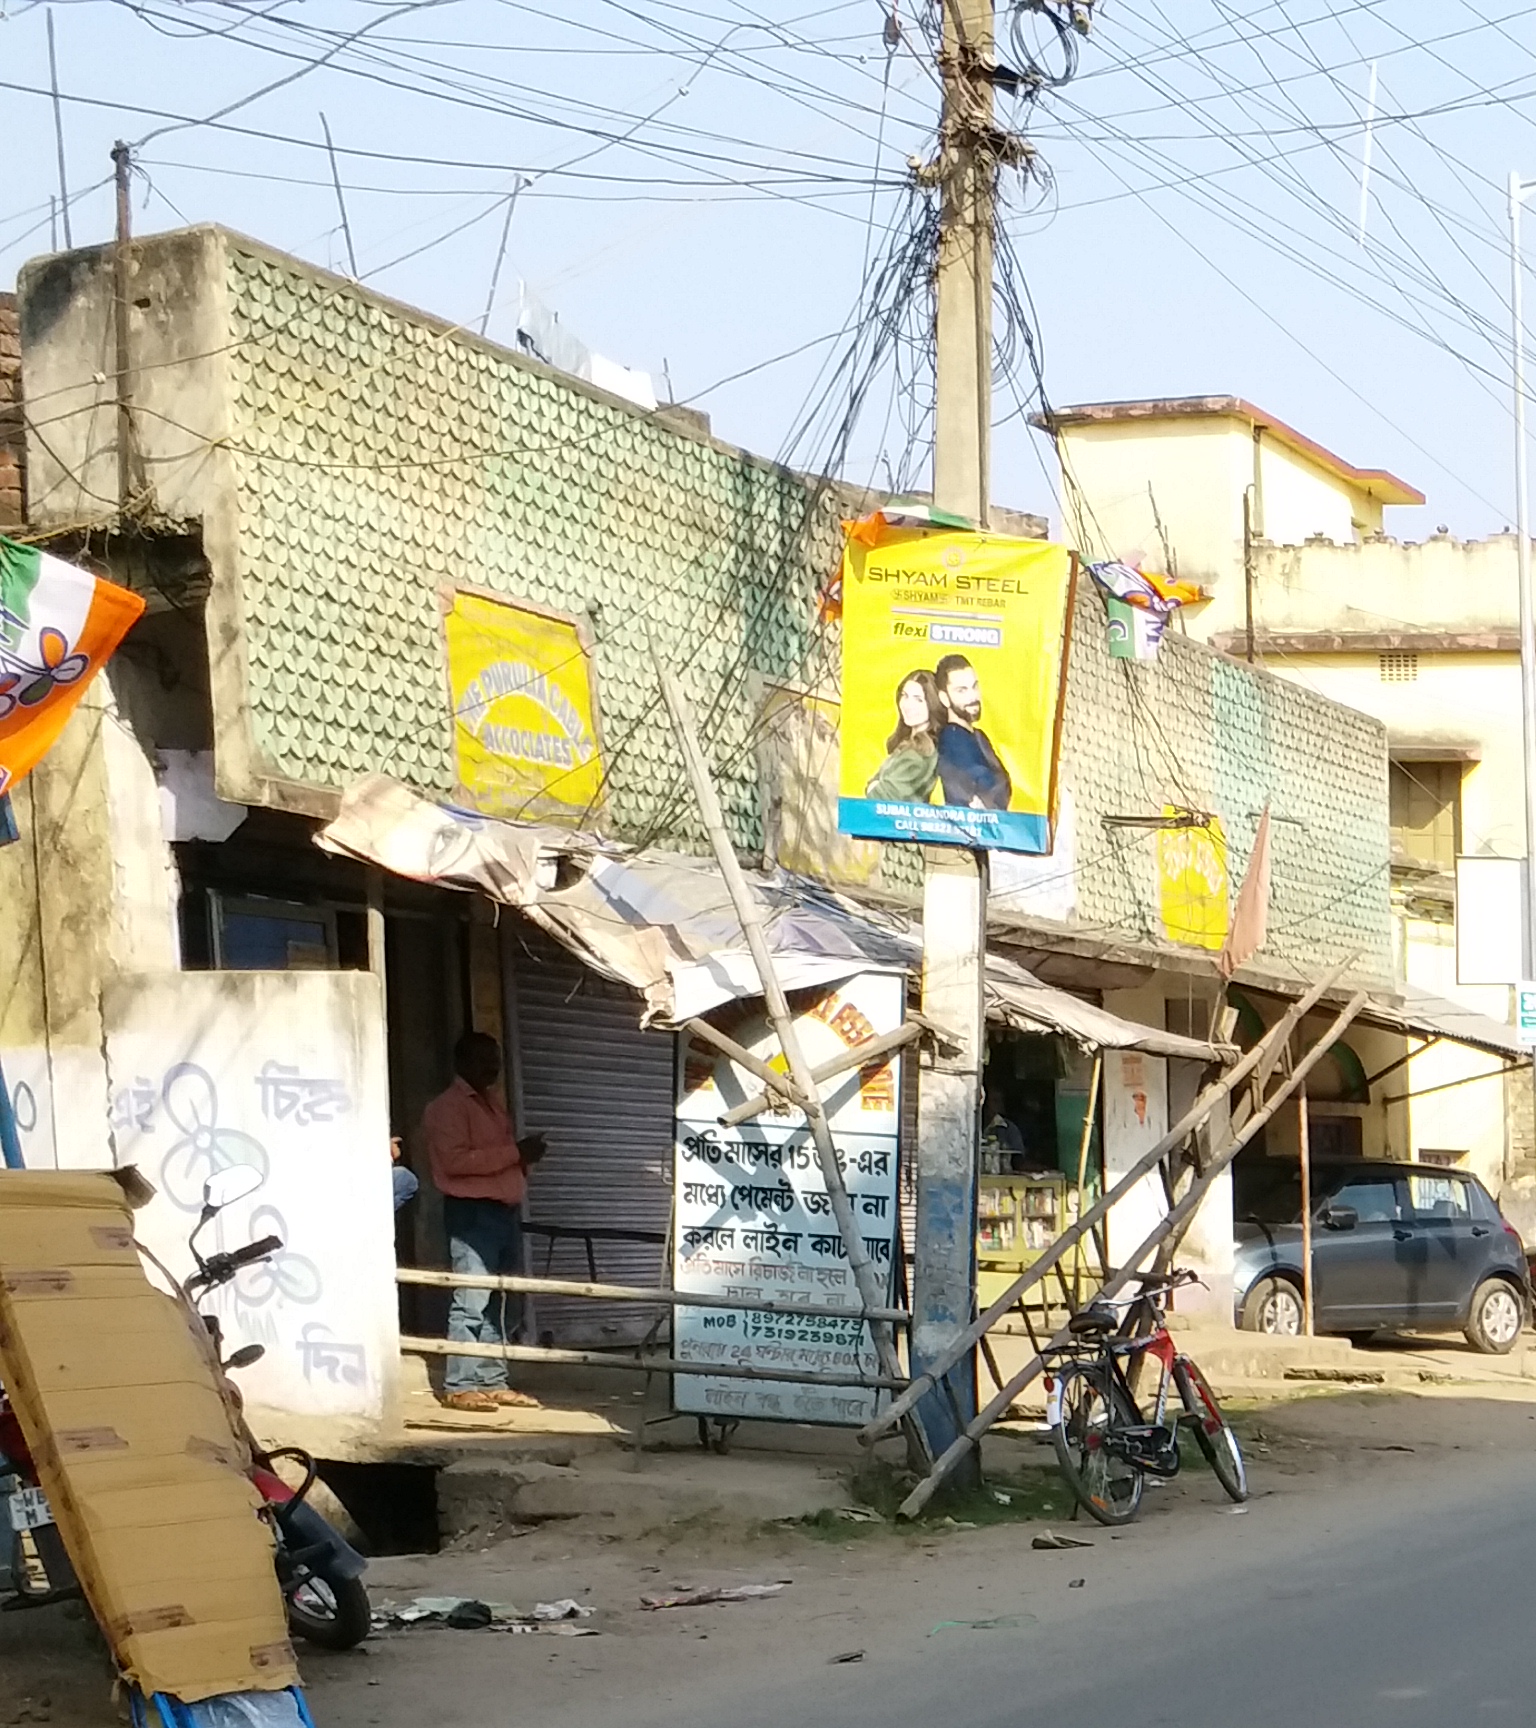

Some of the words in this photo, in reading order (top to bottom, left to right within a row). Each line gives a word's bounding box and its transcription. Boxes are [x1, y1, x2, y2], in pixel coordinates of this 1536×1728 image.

[868, 567, 948, 588] SHYAM
[956, 574, 1029, 596] STEEL
[893, 622, 928, 638] flexi
[931, 624, 999, 645] STRONG
[681, 1128, 722, 1164] প্রতি
[724, 1140, 784, 1170] মাসের
[682, 1181, 726, 1207] মধ্যে
[730, 1178, 795, 1212] পেমেন্ট
[861, 1194, 890, 1219] না
[681, 1225, 736, 1252] করলে
[740, 1222, 803, 1258] লাইন
[703, 1314, 737, 1329] MOB
[296, 1321, 368, 1387] দিন
